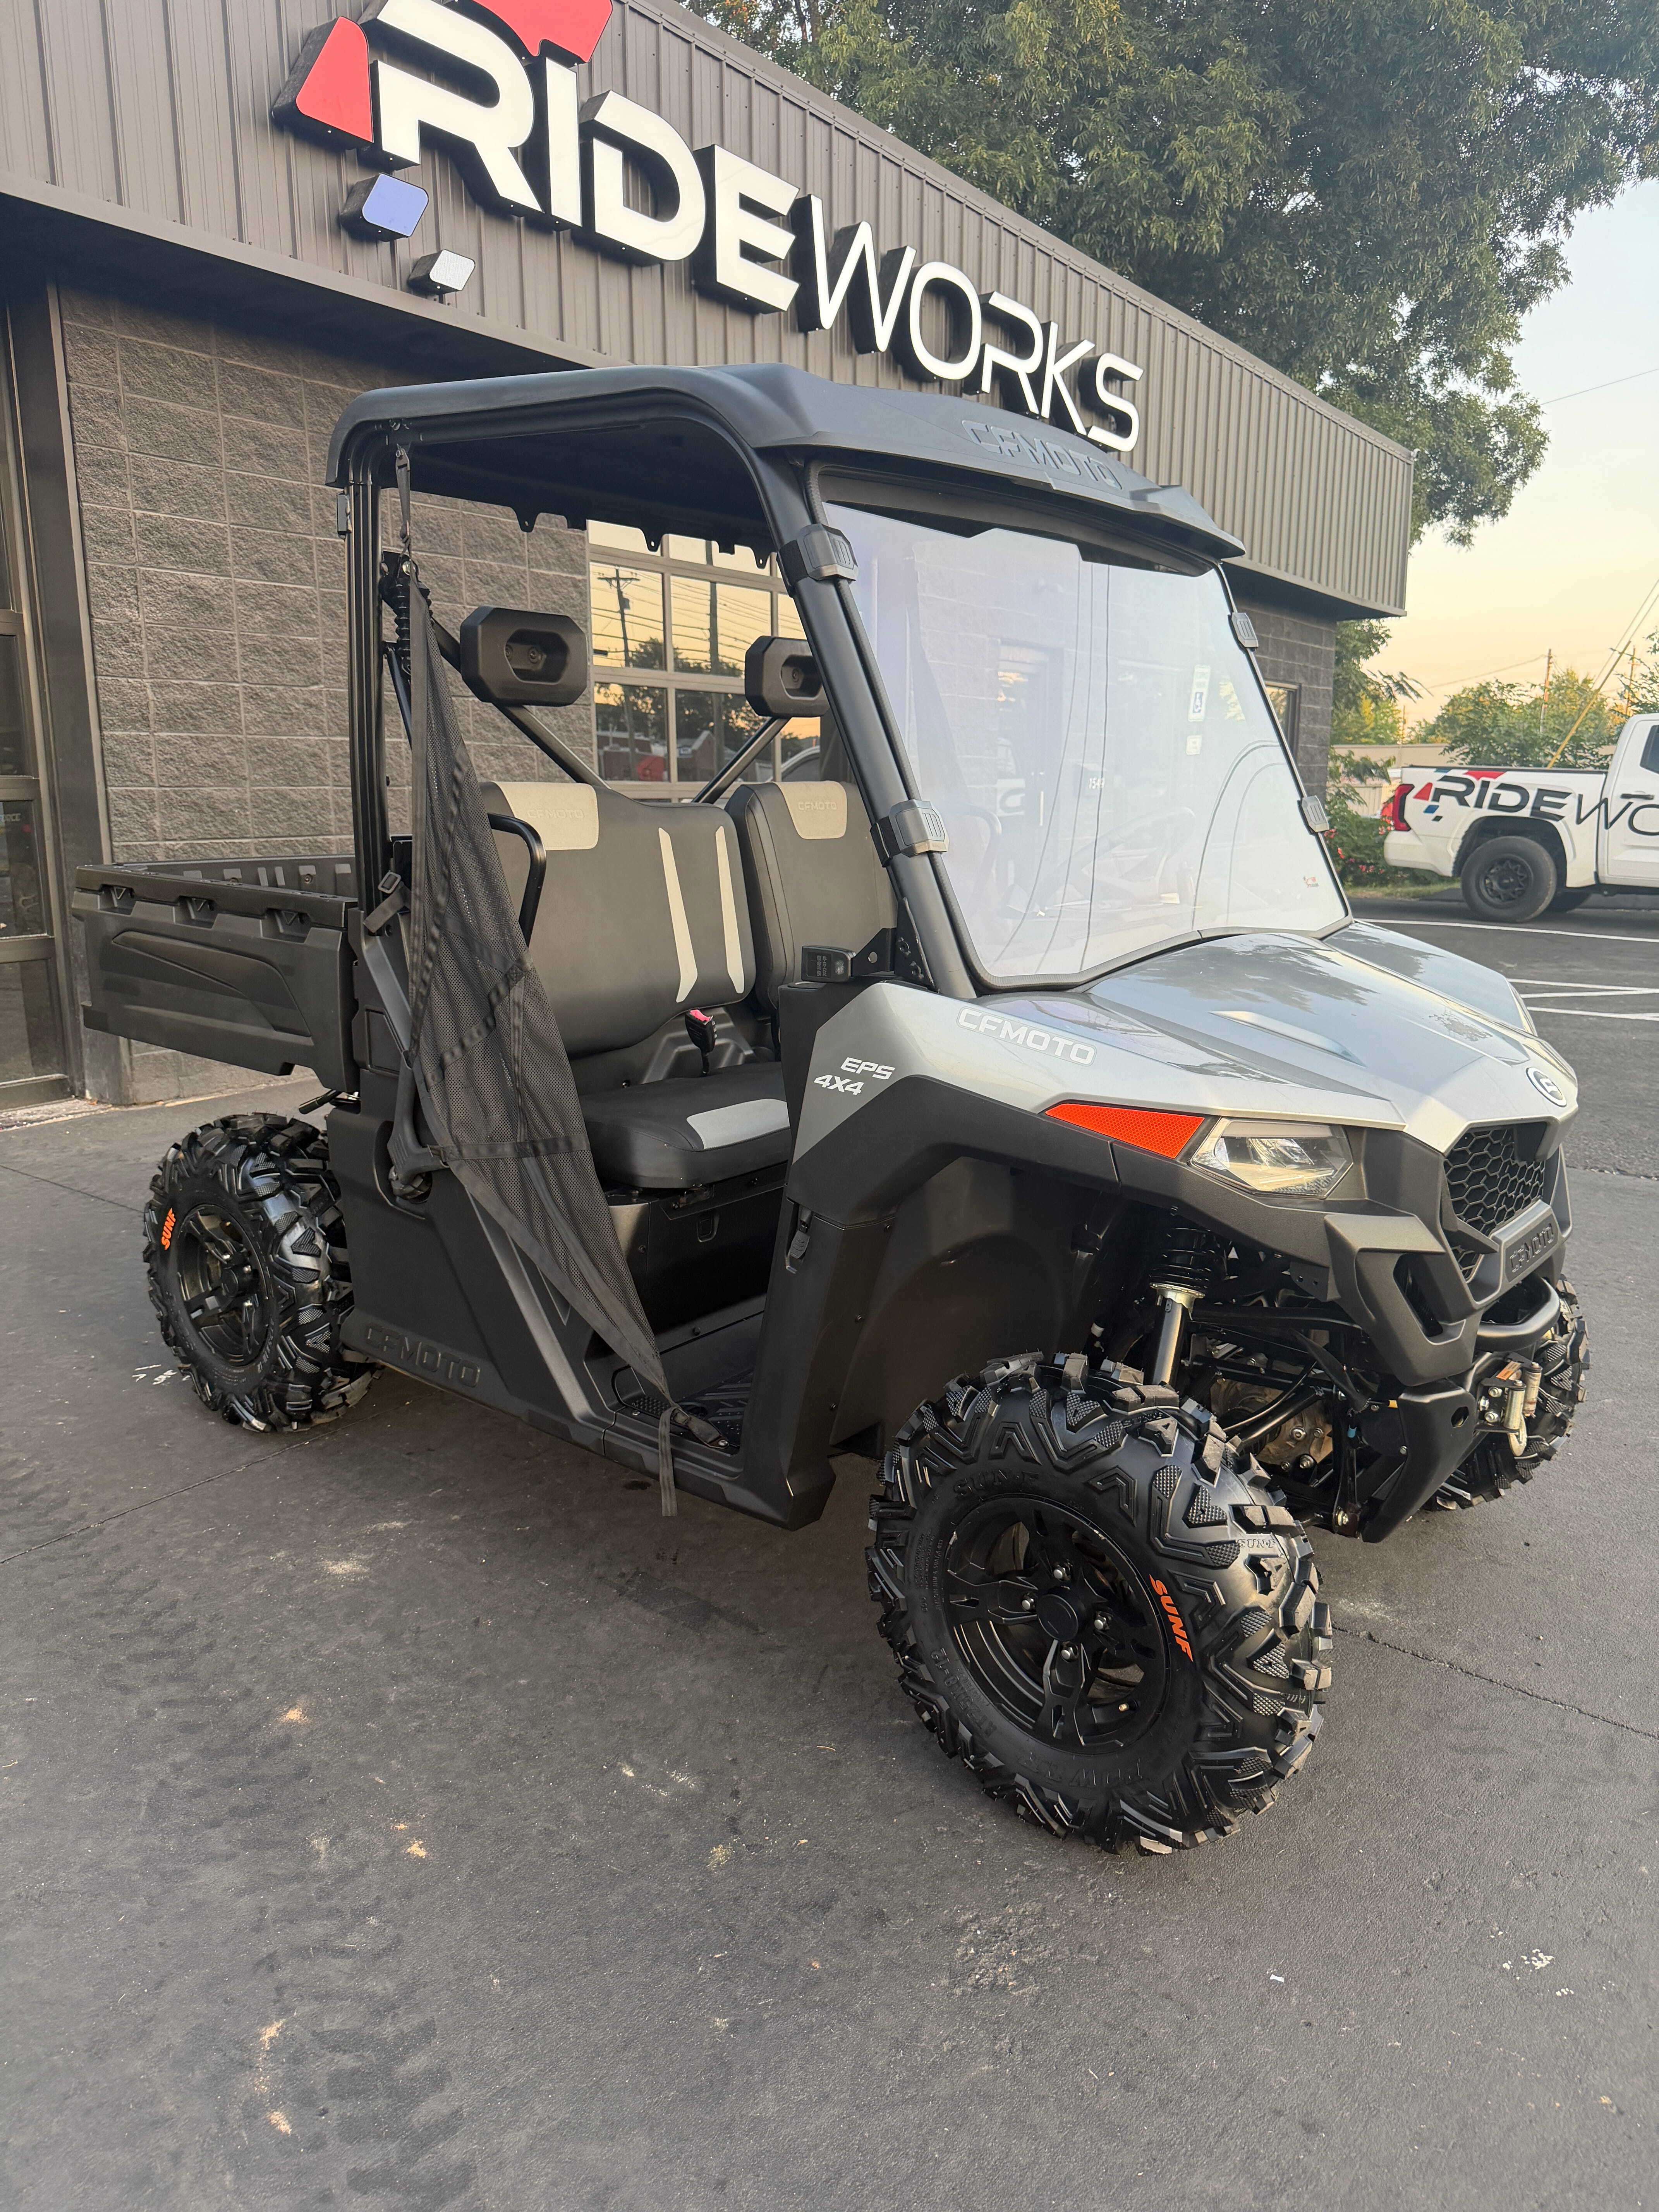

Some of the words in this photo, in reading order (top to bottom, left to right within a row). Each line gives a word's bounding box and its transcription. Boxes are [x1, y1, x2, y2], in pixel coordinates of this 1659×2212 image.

[378, 0, 1144, 452] RIDEWORKS
[962, 420, 1123, 490] CFMOTO
[527, 808, 585, 819] CFMOTO
[798, 802, 837, 811] CFMOTO
[958, 1008, 1095, 1065] CFMOTO
[840, 1057, 896, 1080] EPS
[161, 1207, 176, 1250] SUNF
[1510, 1223, 1554, 1273] CFMOTO
[367, 1323, 481, 1388] CFMOTO
[1149, 1570, 1194, 1662] SUNF
